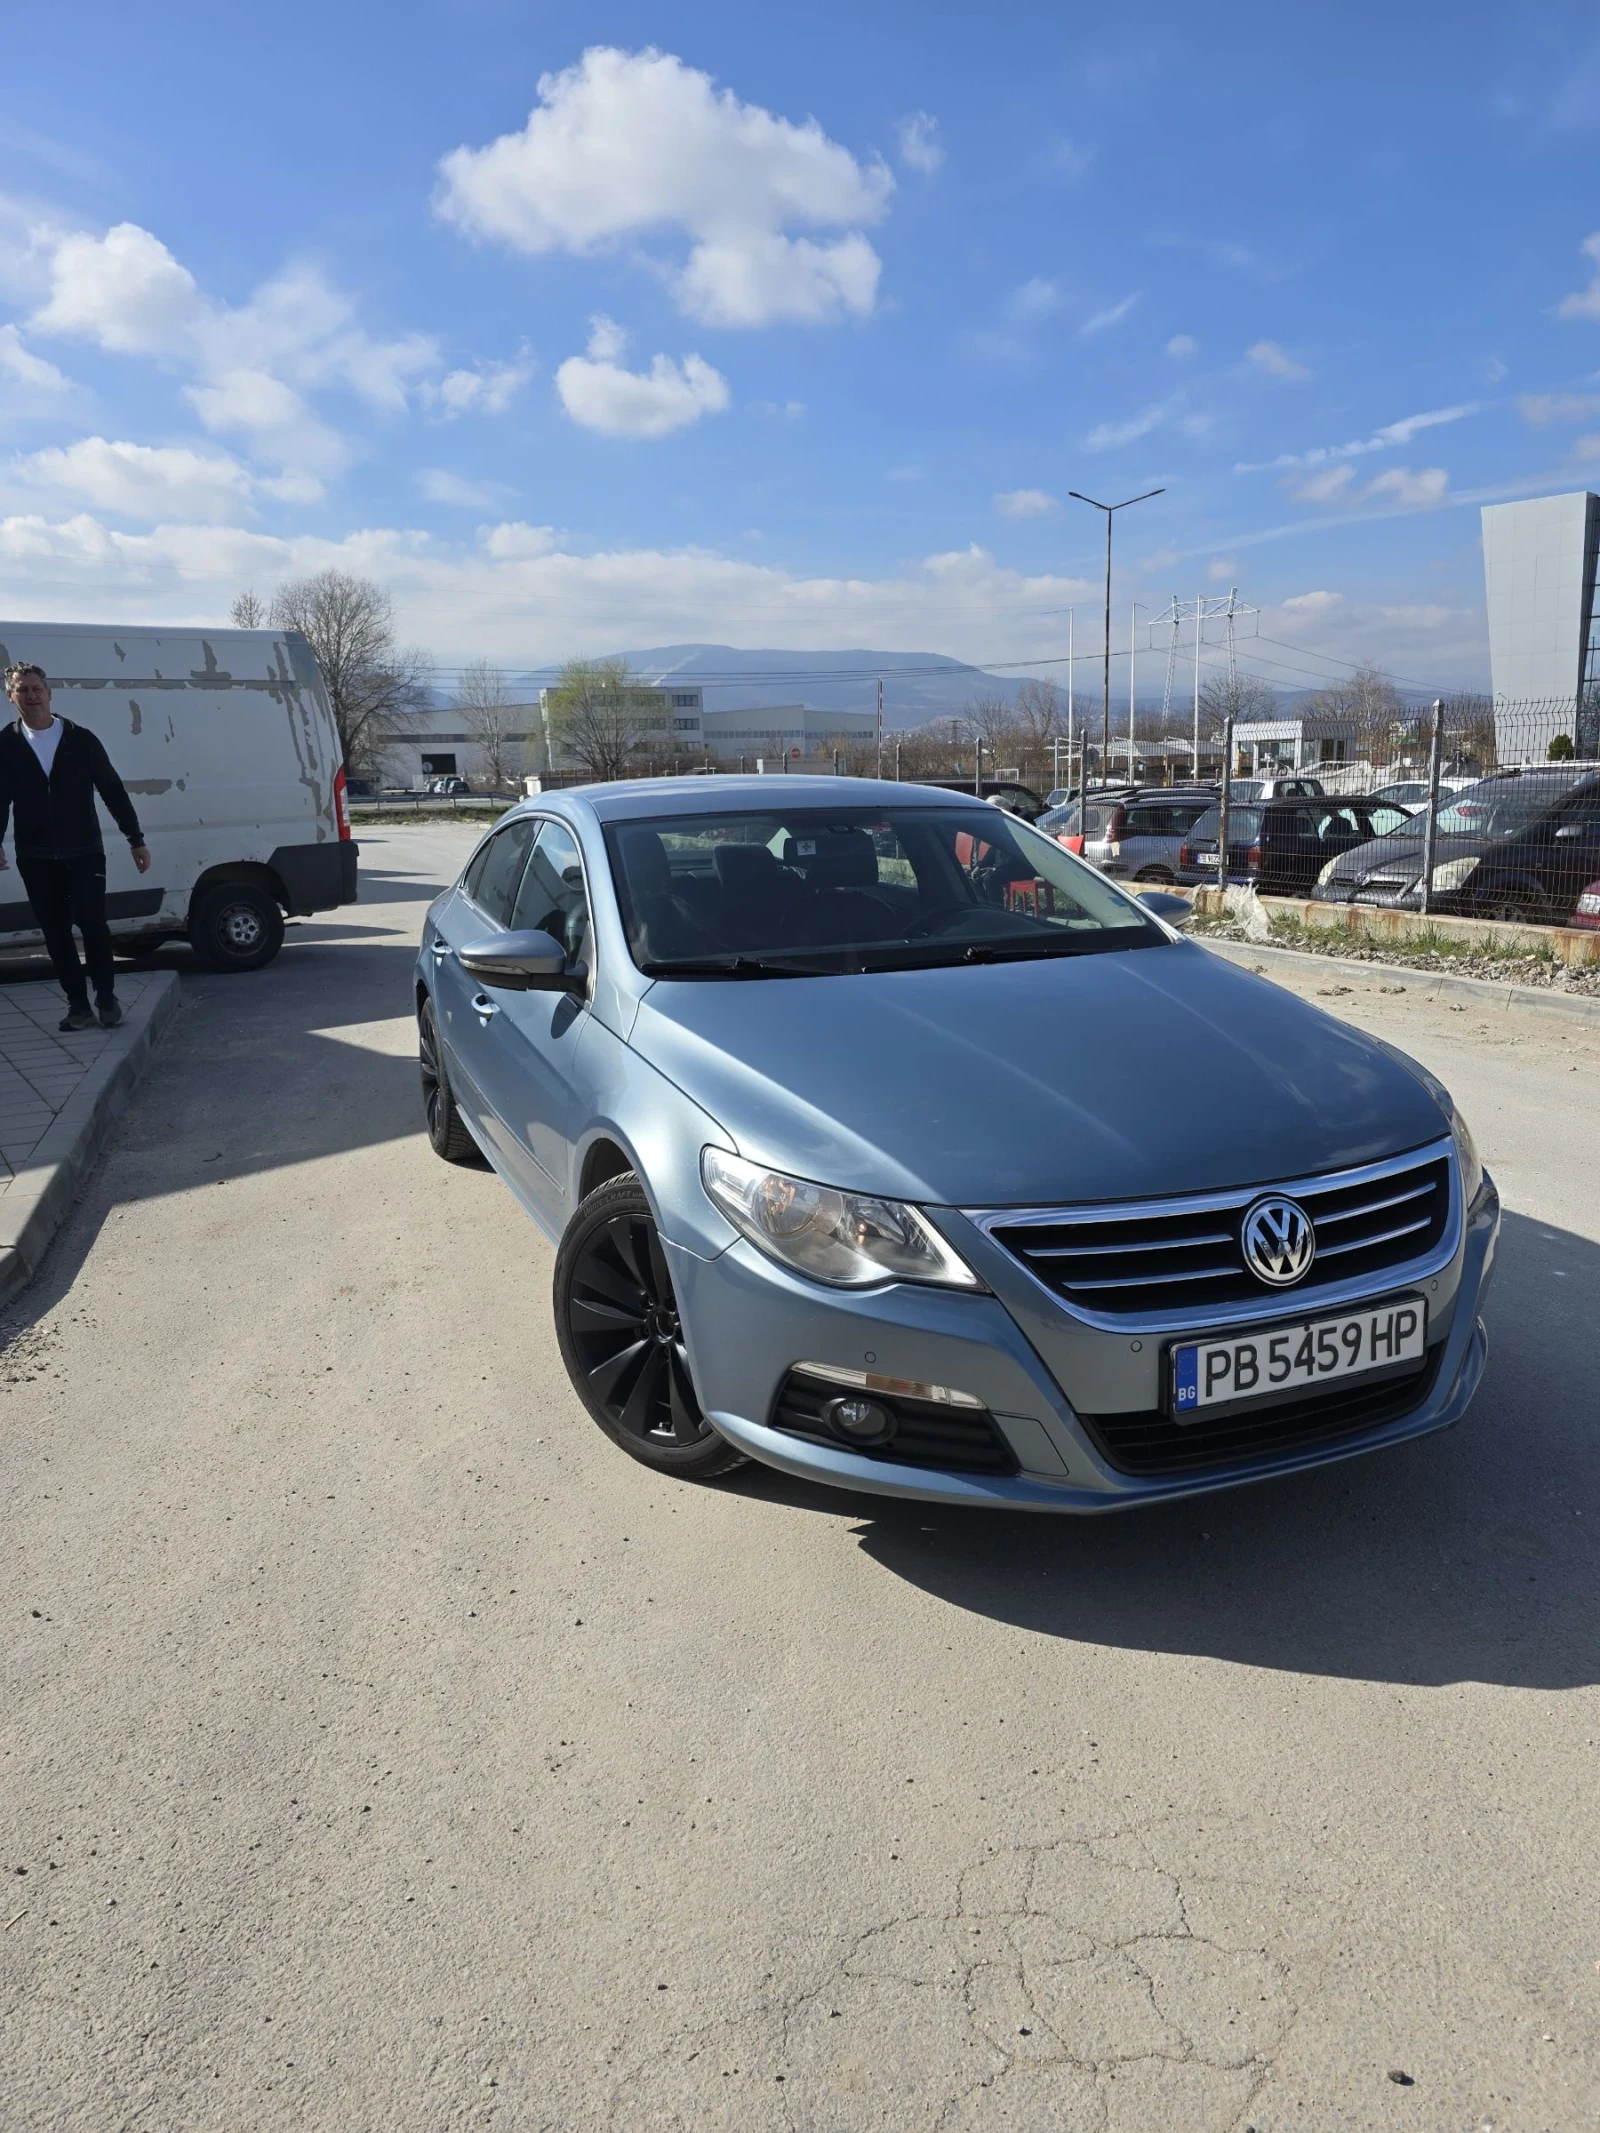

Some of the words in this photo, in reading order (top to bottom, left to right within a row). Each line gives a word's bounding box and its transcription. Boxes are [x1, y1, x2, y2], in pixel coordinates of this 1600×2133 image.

[1247, 1201, 1311, 1280] VW
[1178, 1386, 1196, 1400] BG
[1205, 1344, 1260, 1398] PB
[1268, 1322, 1362, 1383] 5459
[1370, 1309, 1418, 1361] HP
